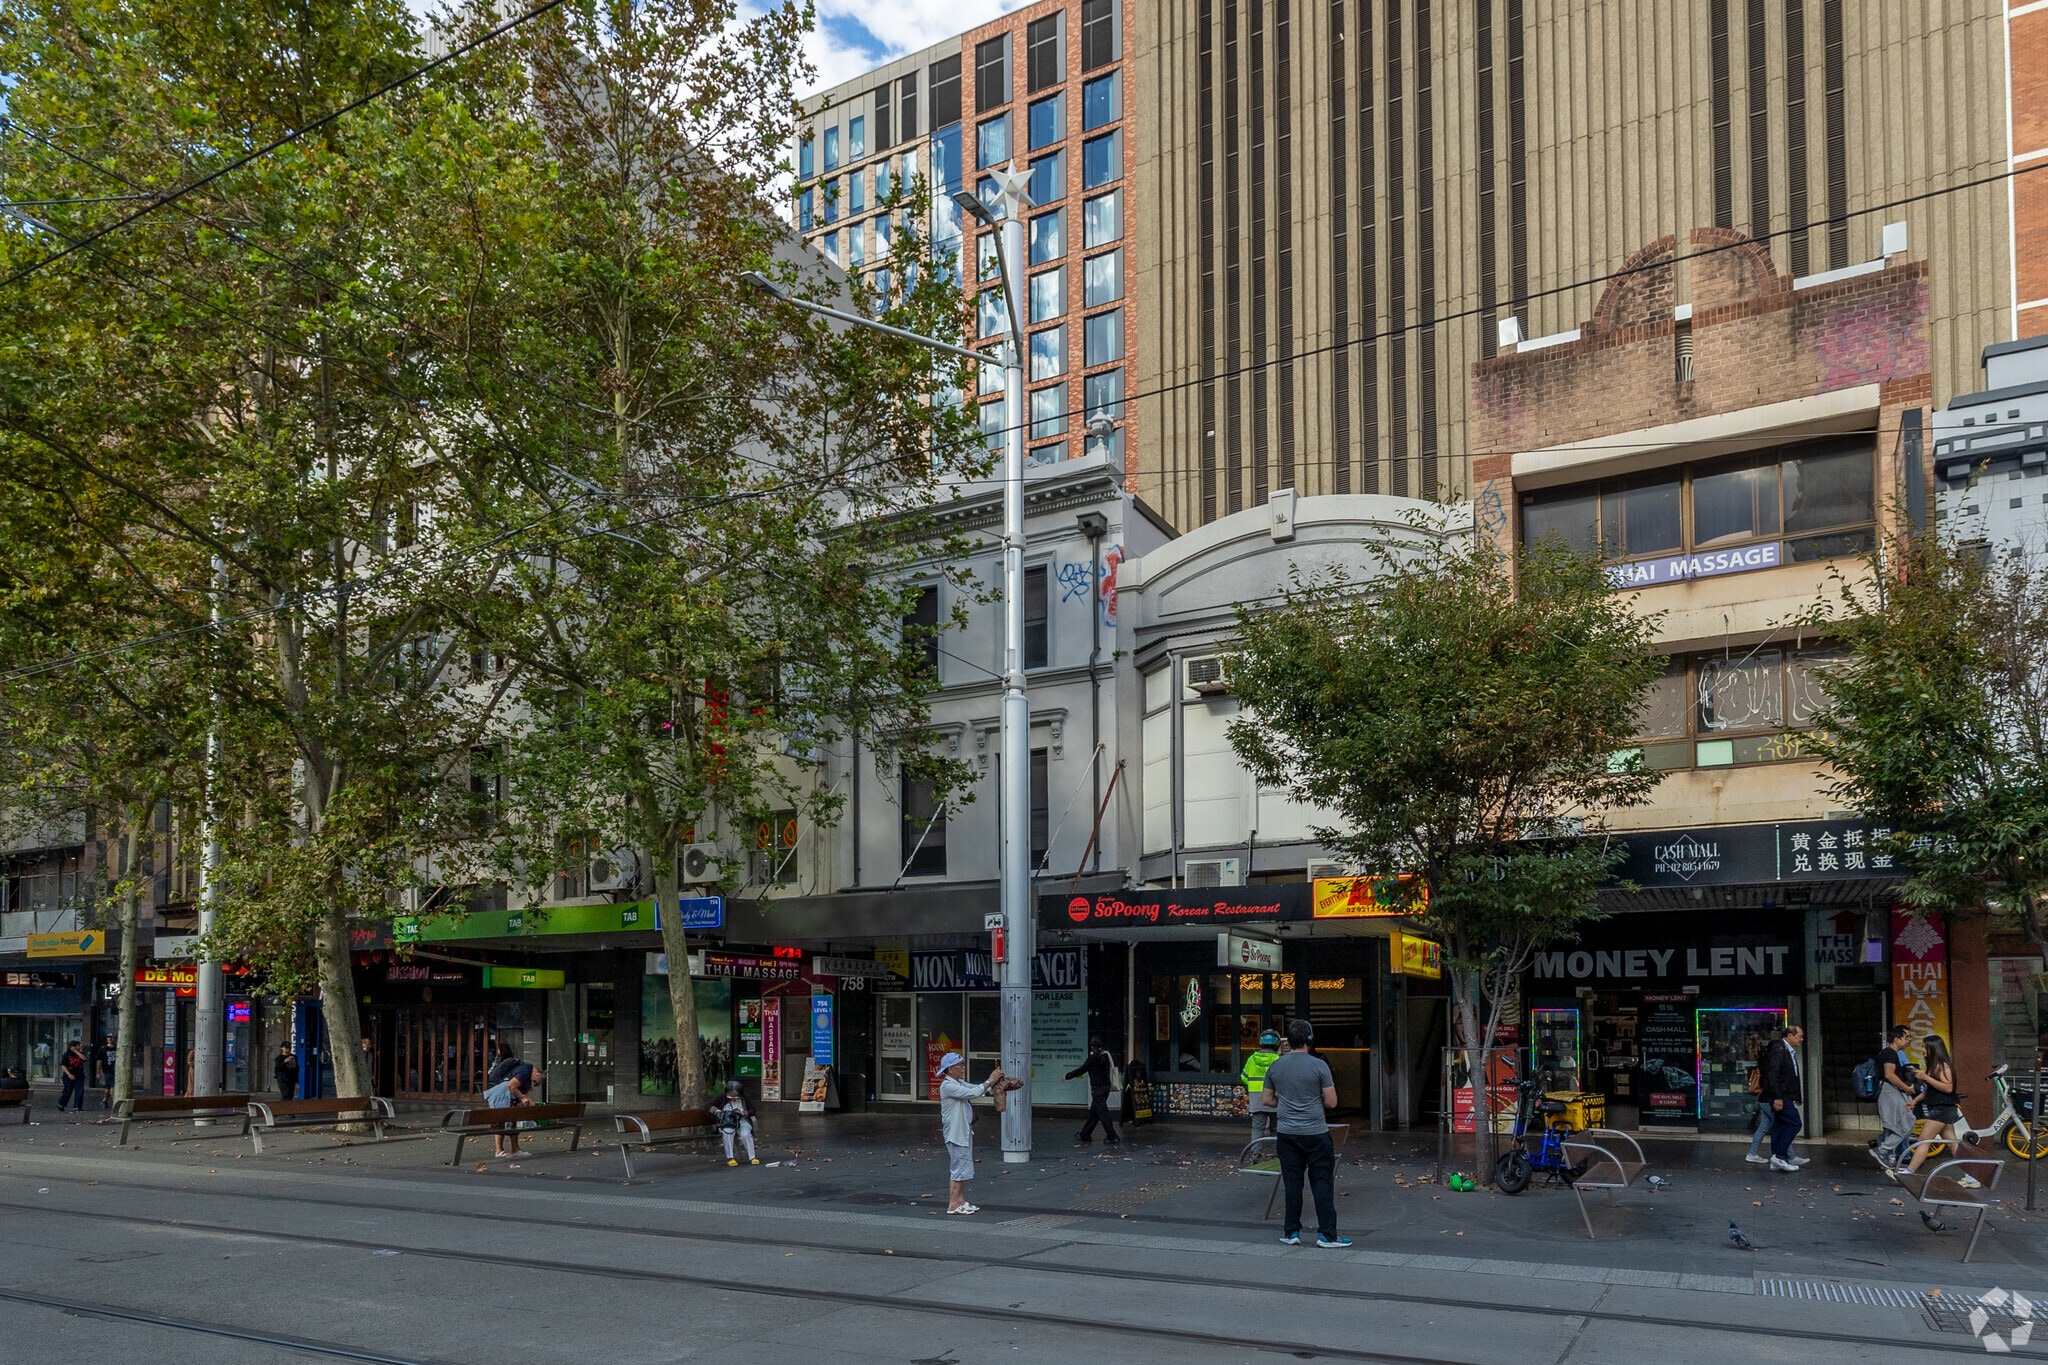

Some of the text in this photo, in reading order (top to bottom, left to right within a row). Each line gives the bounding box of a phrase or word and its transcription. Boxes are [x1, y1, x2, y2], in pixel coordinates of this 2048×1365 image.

[1669, 546, 1775, 577] MASSAGE
[1654, 842, 1721, 860] CASH MALL
[623, 911, 637, 922] TAB
[1094, 901, 1281, 922] SoPoong Korean Restaurant
[509, 918, 522, 928] TAB
[1533, 946, 1789, 978] MONEY LENT
[522, 974, 536, 983] TAB
[705, 964, 800, 979] THAI MASSAGE
[1897, 963, 1942, 980] THAI
[840, 976, 865, 991] 758
[1035, 992, 1074, 1000] FOR LEASE
